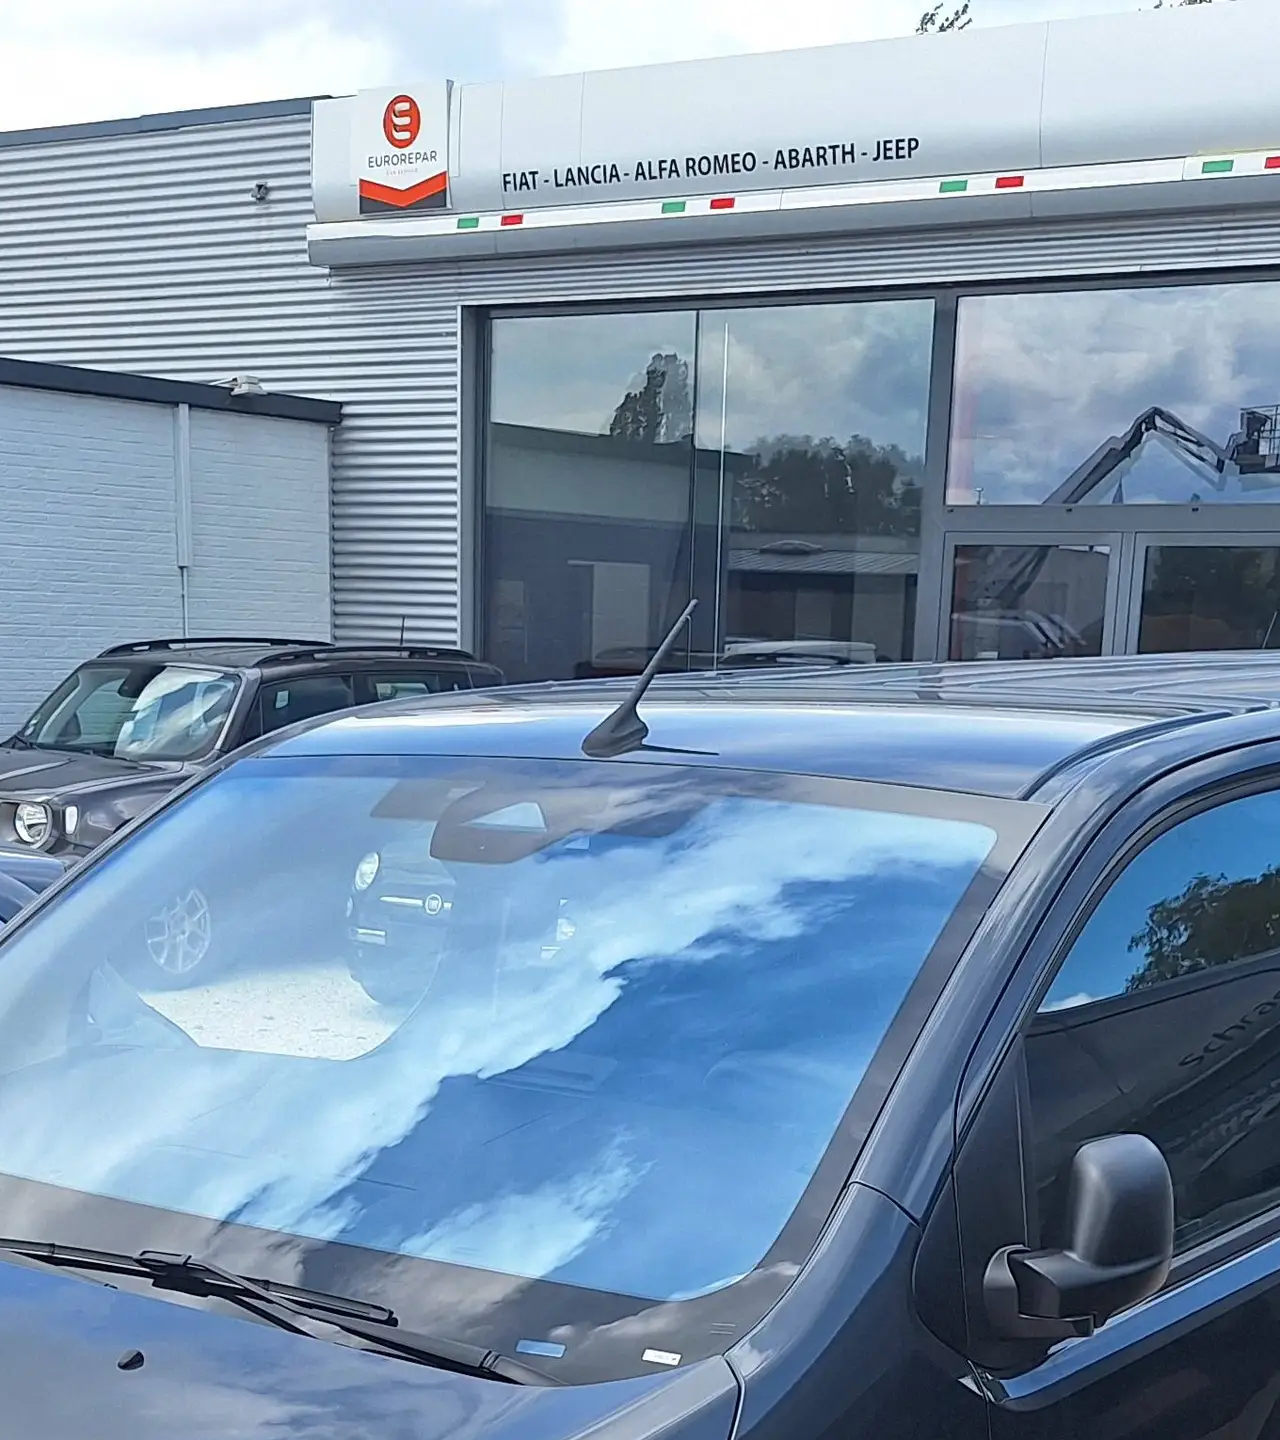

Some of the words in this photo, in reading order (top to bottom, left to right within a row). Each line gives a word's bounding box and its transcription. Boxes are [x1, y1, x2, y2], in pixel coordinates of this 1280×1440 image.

[368, 150, 438, 168] EUROREPAR
[502, 171, 539, 192] FIAT
[554, 163, 621, 188] LANCIA
[634, 159, 681, 182] ALFA
[685, 151, 756, 178] ROMEO
[774, 142, 856, 170] ABARTH
[872, 137, 919, 161] JEEP
